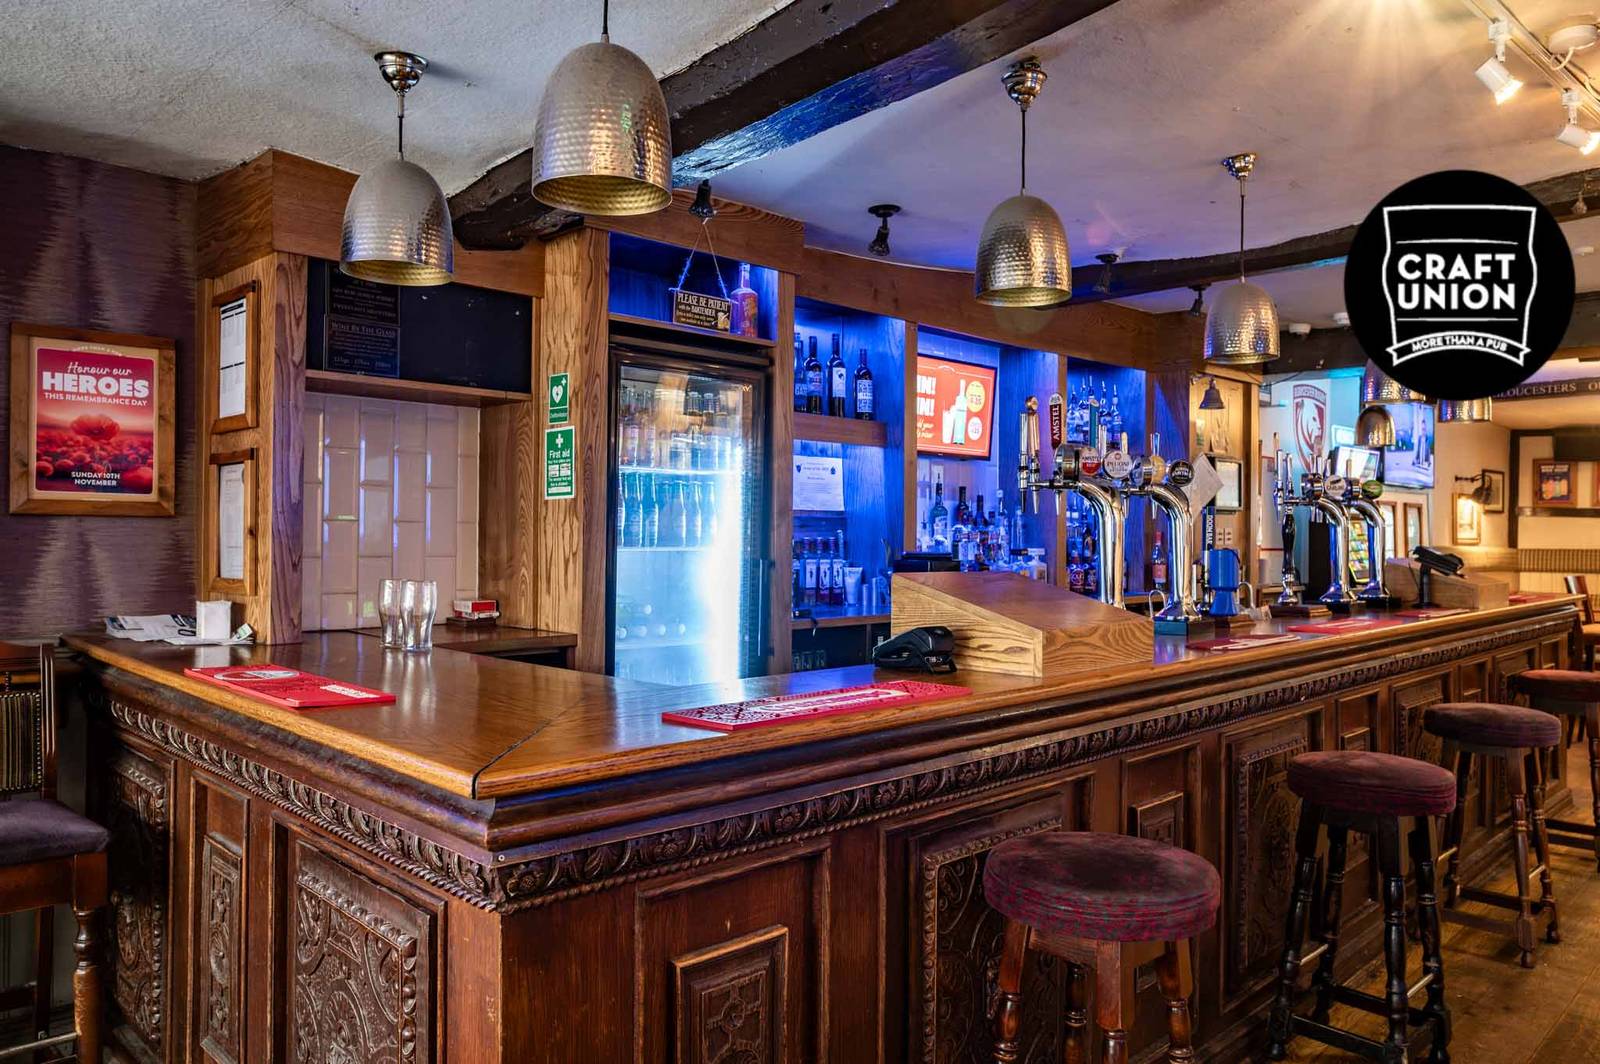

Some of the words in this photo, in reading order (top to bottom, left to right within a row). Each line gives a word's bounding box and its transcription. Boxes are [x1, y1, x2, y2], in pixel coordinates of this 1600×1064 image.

[677, 293, 698, 306] PLEASE
[699, 297, 707, 307] BE
[708, 299, 729, 311] PATIENT
[691, 305, 716, 317] BARTENDER
[67, 361, 109, 375] Honour
[112, 368, 133, 376] our
[42, 371, 150, 398] HEROES
[44, 392, 64, 401] THIS
[65, 393, 130, 406] REMEMBRANCE
[130, 398, 148, 407] DAY
[1052, 405, 1061, 441] AMSTEL
[549, 450, 561, 459] First
[562, 448, 571, 457] aid
[71, 471, 102, 479] SUNDAY
[103, 472, 121, 480] 10TH
[74, 478, 117, 486] NOVEMBER
